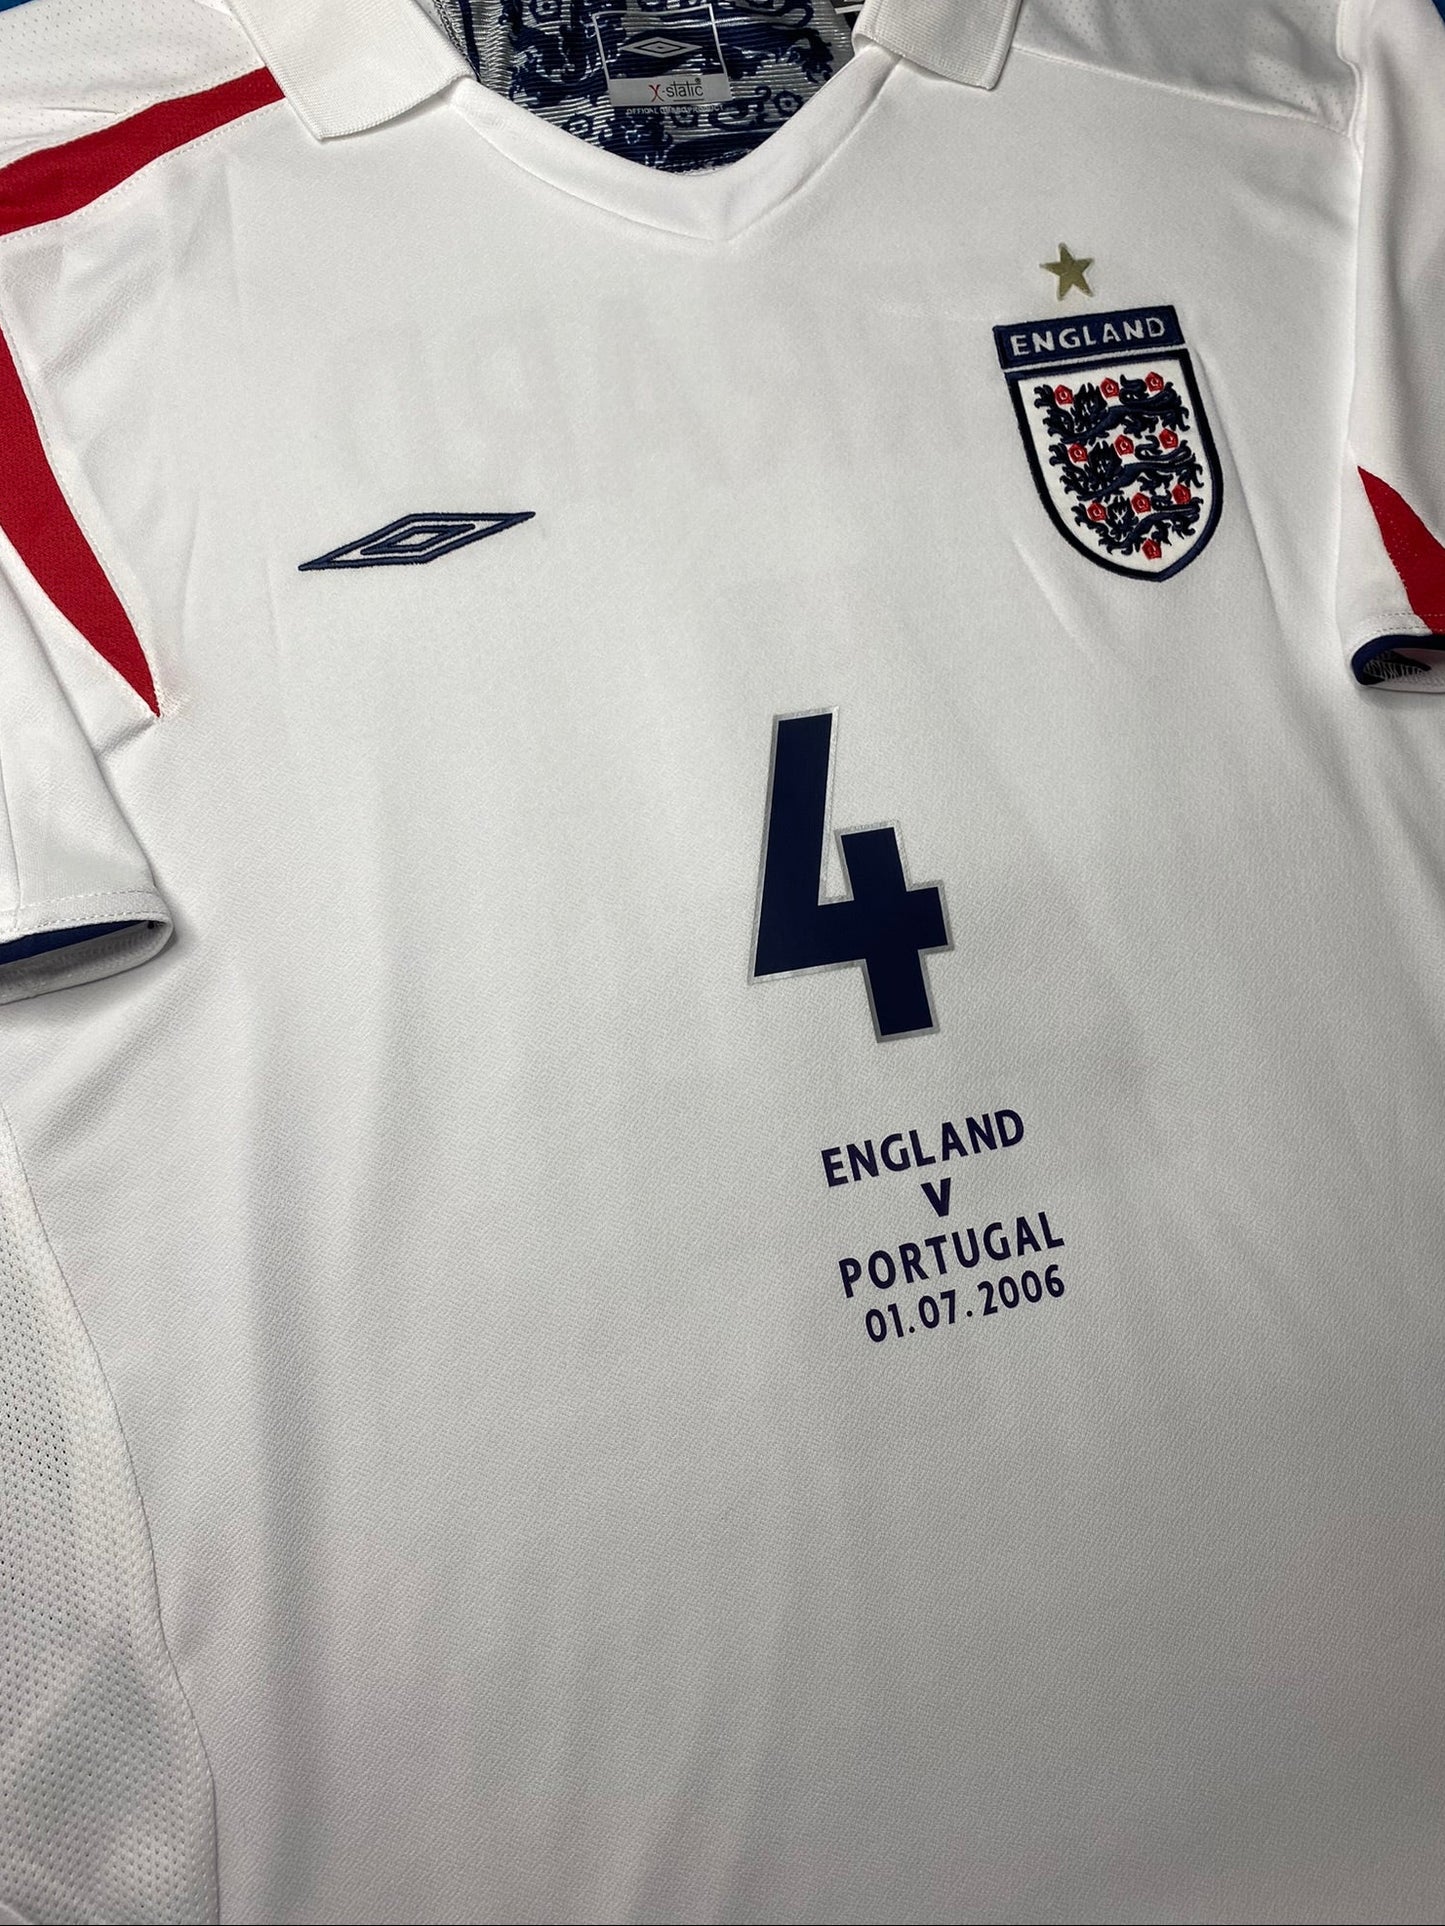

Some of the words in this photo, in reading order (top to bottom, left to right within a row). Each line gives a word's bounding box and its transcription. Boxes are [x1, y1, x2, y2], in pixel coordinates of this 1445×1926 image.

[1010, 316, 1166, 357] ENGLAND
[748, 706, 954, 1043] 4
[820, 1108, 1025, 1188] ENGLAND
[920, 1176, 952, 1218] V
[838, 1211, 1066, 1299] PORTUGAL
[865, 1263, 1066, 1344] 01.07.2006
